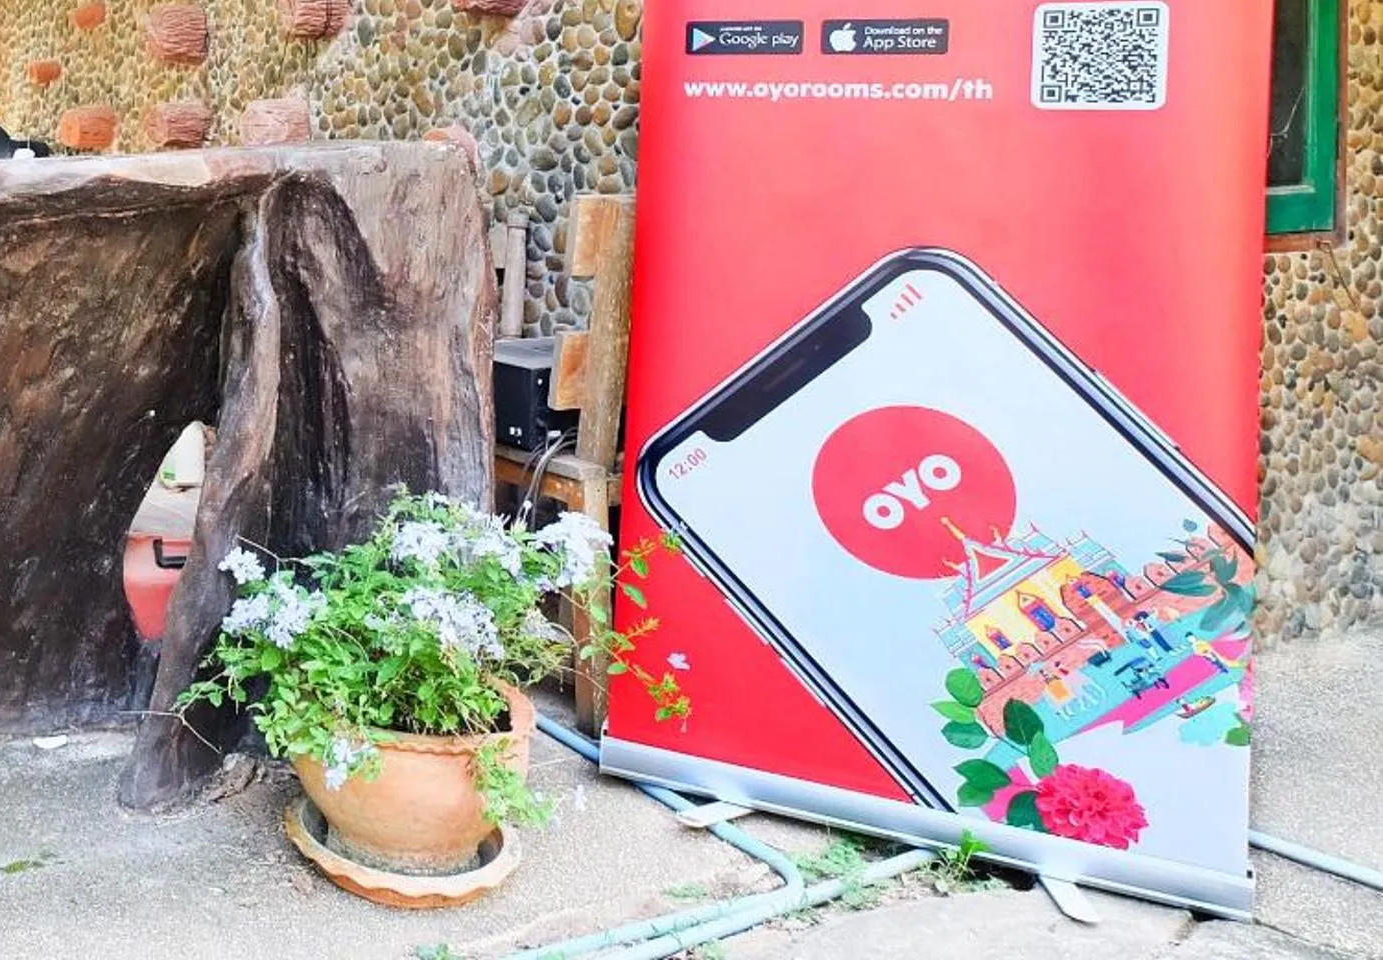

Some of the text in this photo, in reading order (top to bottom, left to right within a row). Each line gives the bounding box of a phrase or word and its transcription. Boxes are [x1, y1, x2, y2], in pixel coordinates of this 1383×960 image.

[719, 31, 768, 50] Google
[864, 25, 943, 36] Download on the
[863, 35, 938, 51] App Store
[683, 78, 994, 103] www.oyorooms.com/th
[667, 446, 708, 481] 12:00
[862, 453, 962, 530] OYO
